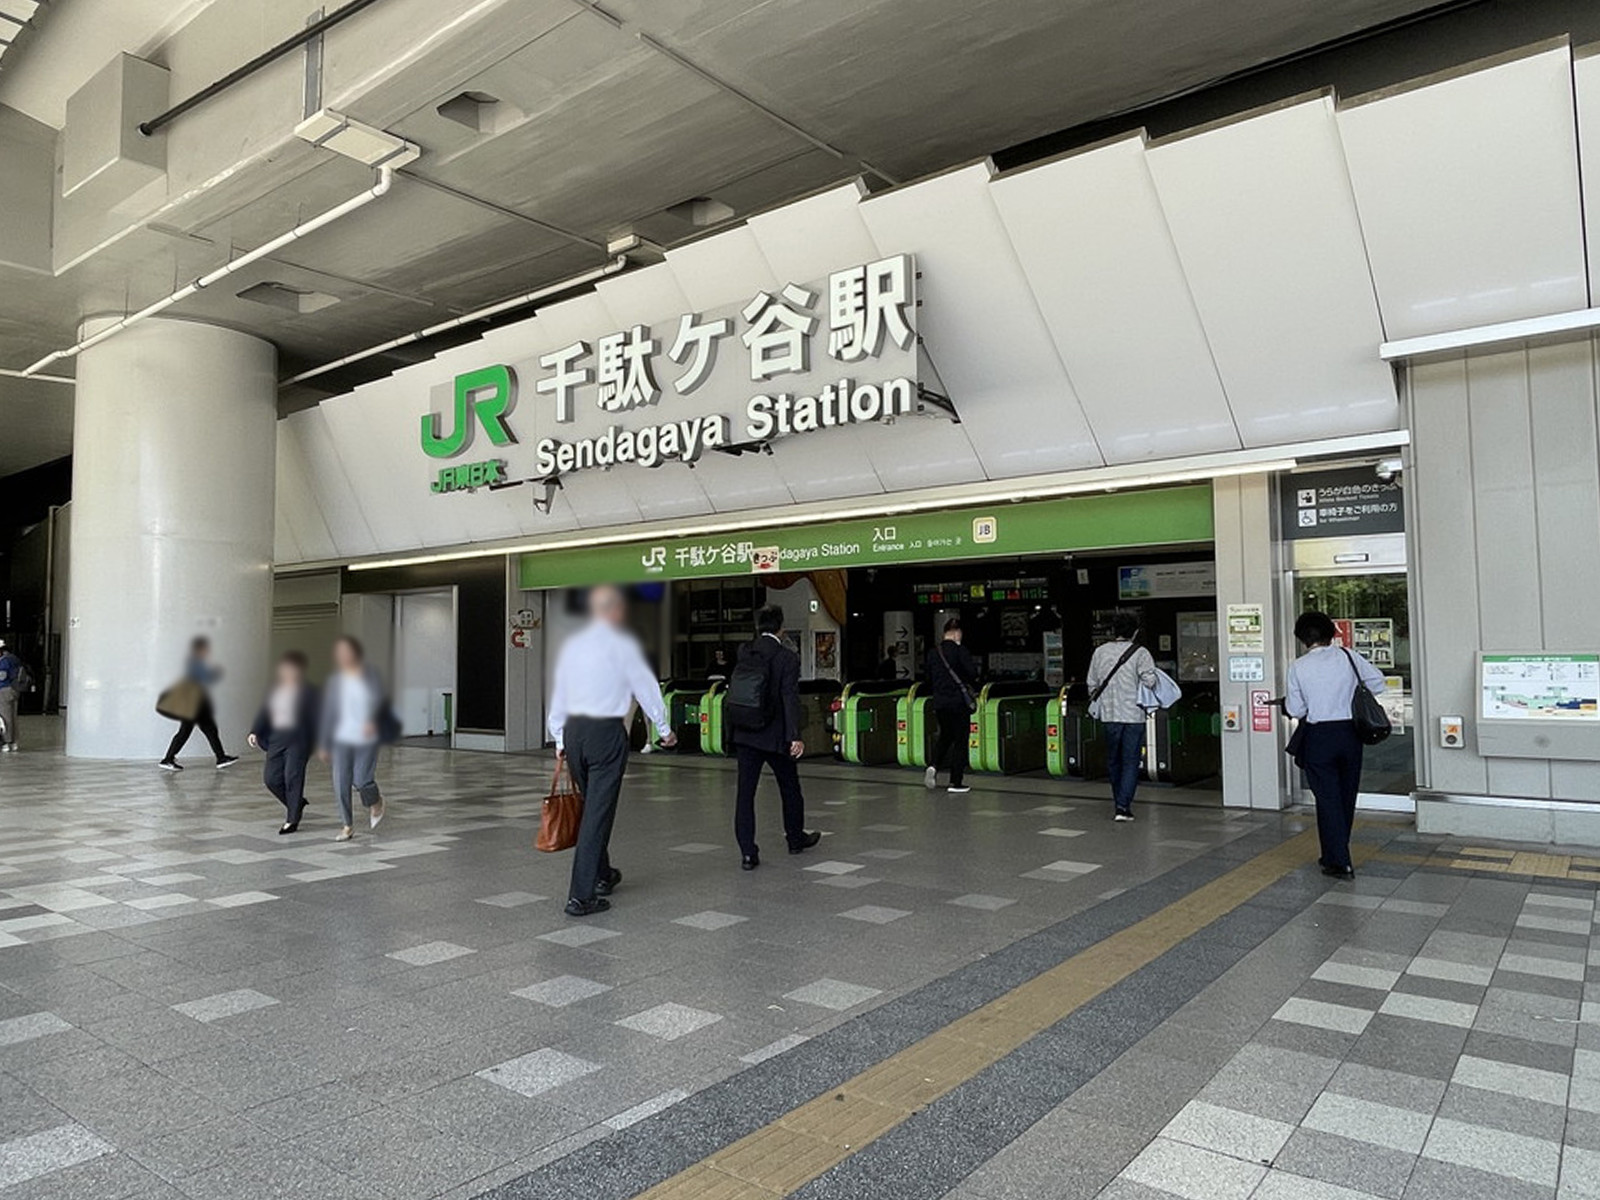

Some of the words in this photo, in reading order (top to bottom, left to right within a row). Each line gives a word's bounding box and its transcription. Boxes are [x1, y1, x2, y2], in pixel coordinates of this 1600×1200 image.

[421, 363, 517, 458] JR
[536, 414, 727, 476] Sendagaya
[746, 377, 913, 441] Station
[873, 527, 896, 541] 入口
[979, 524, 991, 535] JB
[641, 547, 666, 567] JR
[821, 543, 860, 556] Station
